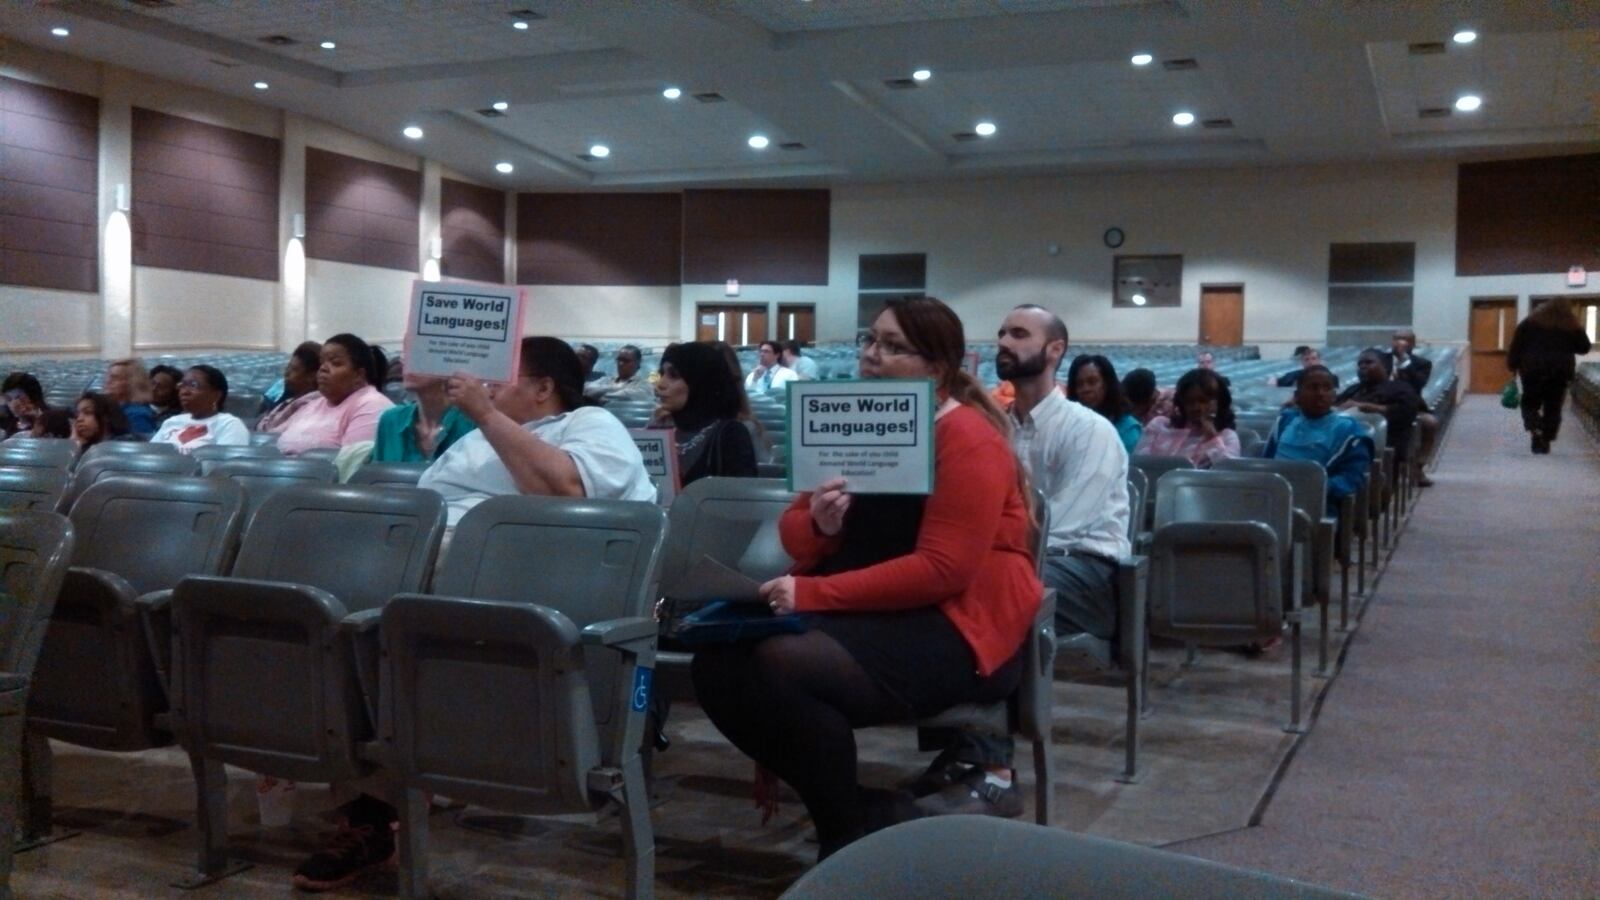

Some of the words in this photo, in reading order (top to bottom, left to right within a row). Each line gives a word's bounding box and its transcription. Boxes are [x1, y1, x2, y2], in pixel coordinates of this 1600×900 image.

[426, 296, 458, 309] Save
[463, 298, 504, 312] World
[424, 313, 506, 331] Languages!
[808, 399, 851, 413] Save
[857, 399, 910, 412] World
[809, 420, 914, 436] Languages!
[638, 443, 658, 452] orld
